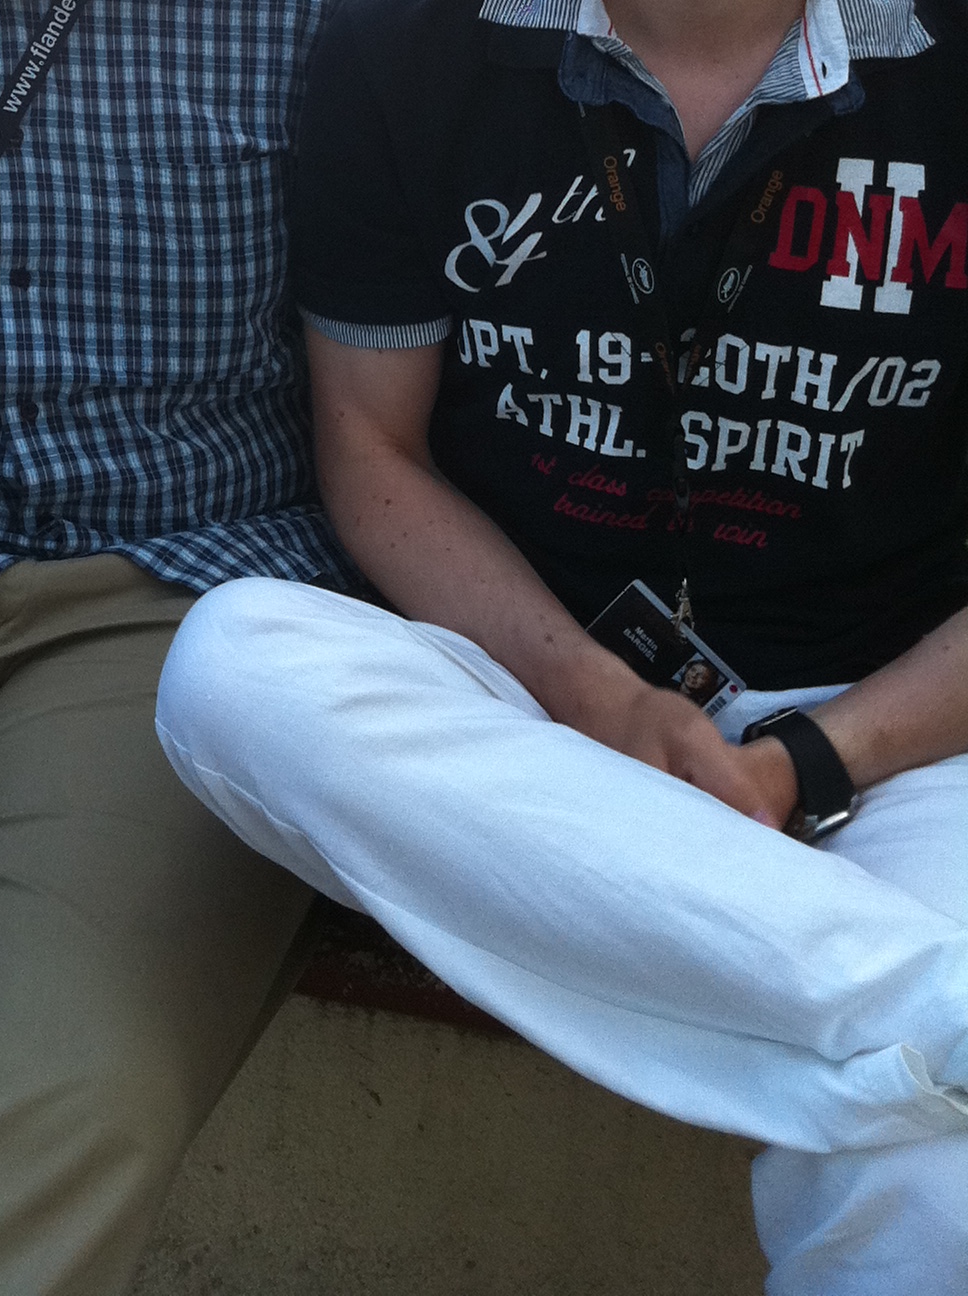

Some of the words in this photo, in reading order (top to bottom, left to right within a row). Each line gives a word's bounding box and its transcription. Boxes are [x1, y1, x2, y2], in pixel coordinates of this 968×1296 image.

[604, 155, 626, 212] Orange
[751, 170, 783, 223] Orange
[495, 382, 646, 458] ATHL.
[680, 410, 865, 489] SPIRIT
[567, 463, 628, 497] class
[634, 626, 658, 652] Martin
